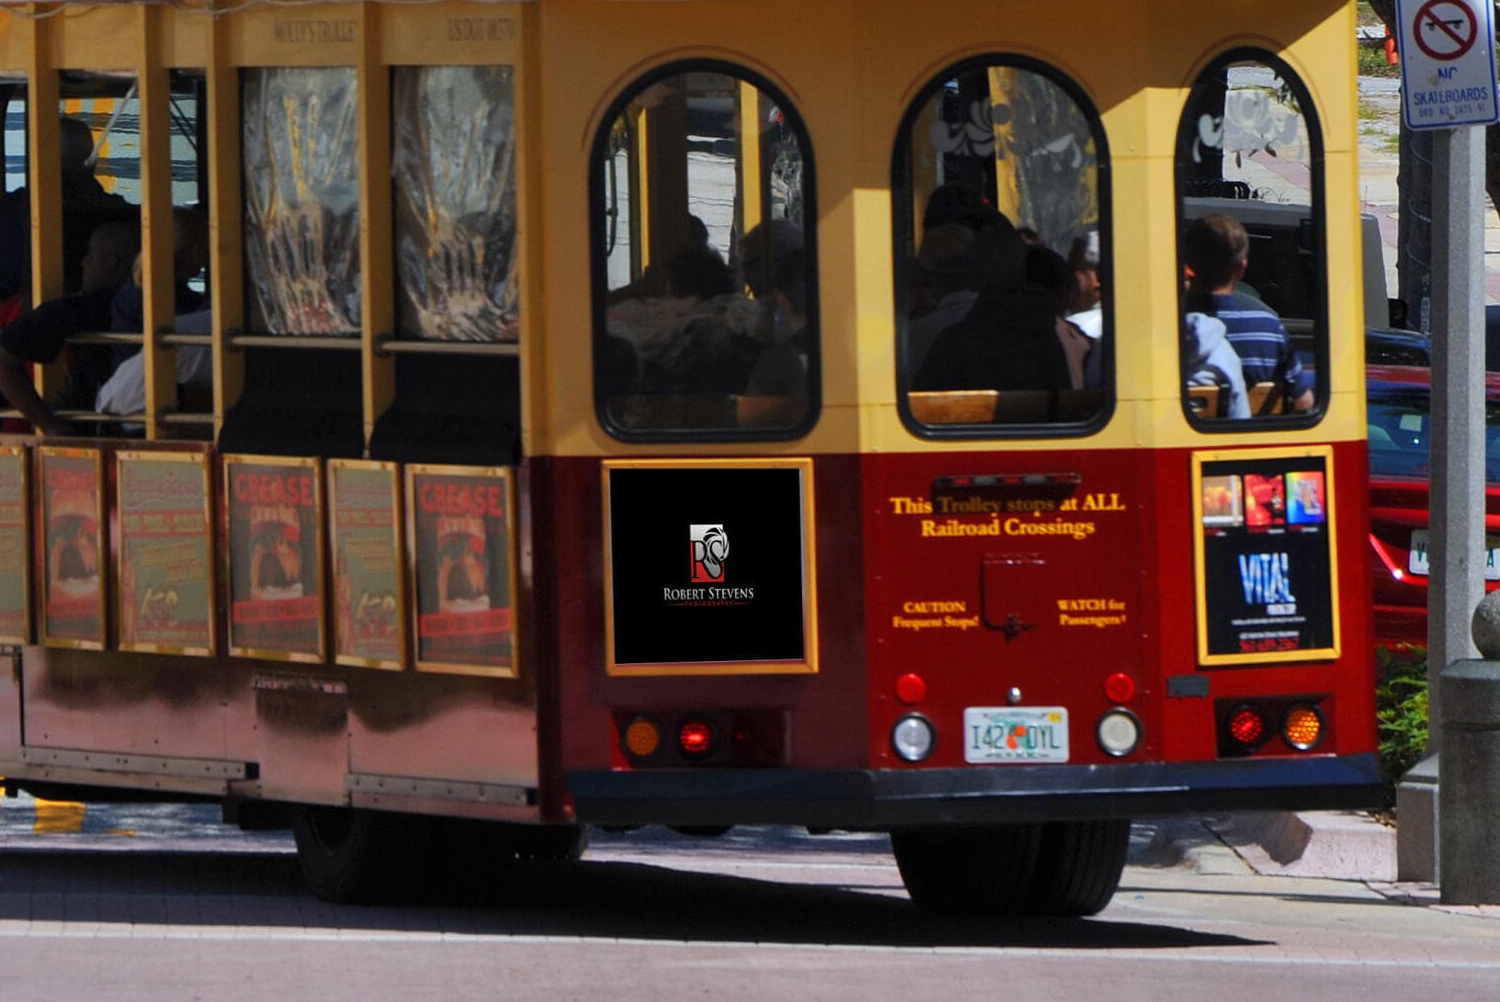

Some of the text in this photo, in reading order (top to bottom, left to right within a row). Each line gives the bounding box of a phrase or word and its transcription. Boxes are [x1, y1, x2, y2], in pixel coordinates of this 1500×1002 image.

[1413, 86, 1488, 106] SKATEBOARDS
[890, 493, 1126, 517] This Trolley stops at ALL
[921, 517, 1095, 540] Railroad Crossings
[903, 601, 966, 614] CAUTION
[1057, 598, 1126, 611] WATCH for
[892, 616, 943, 630] Frequent
